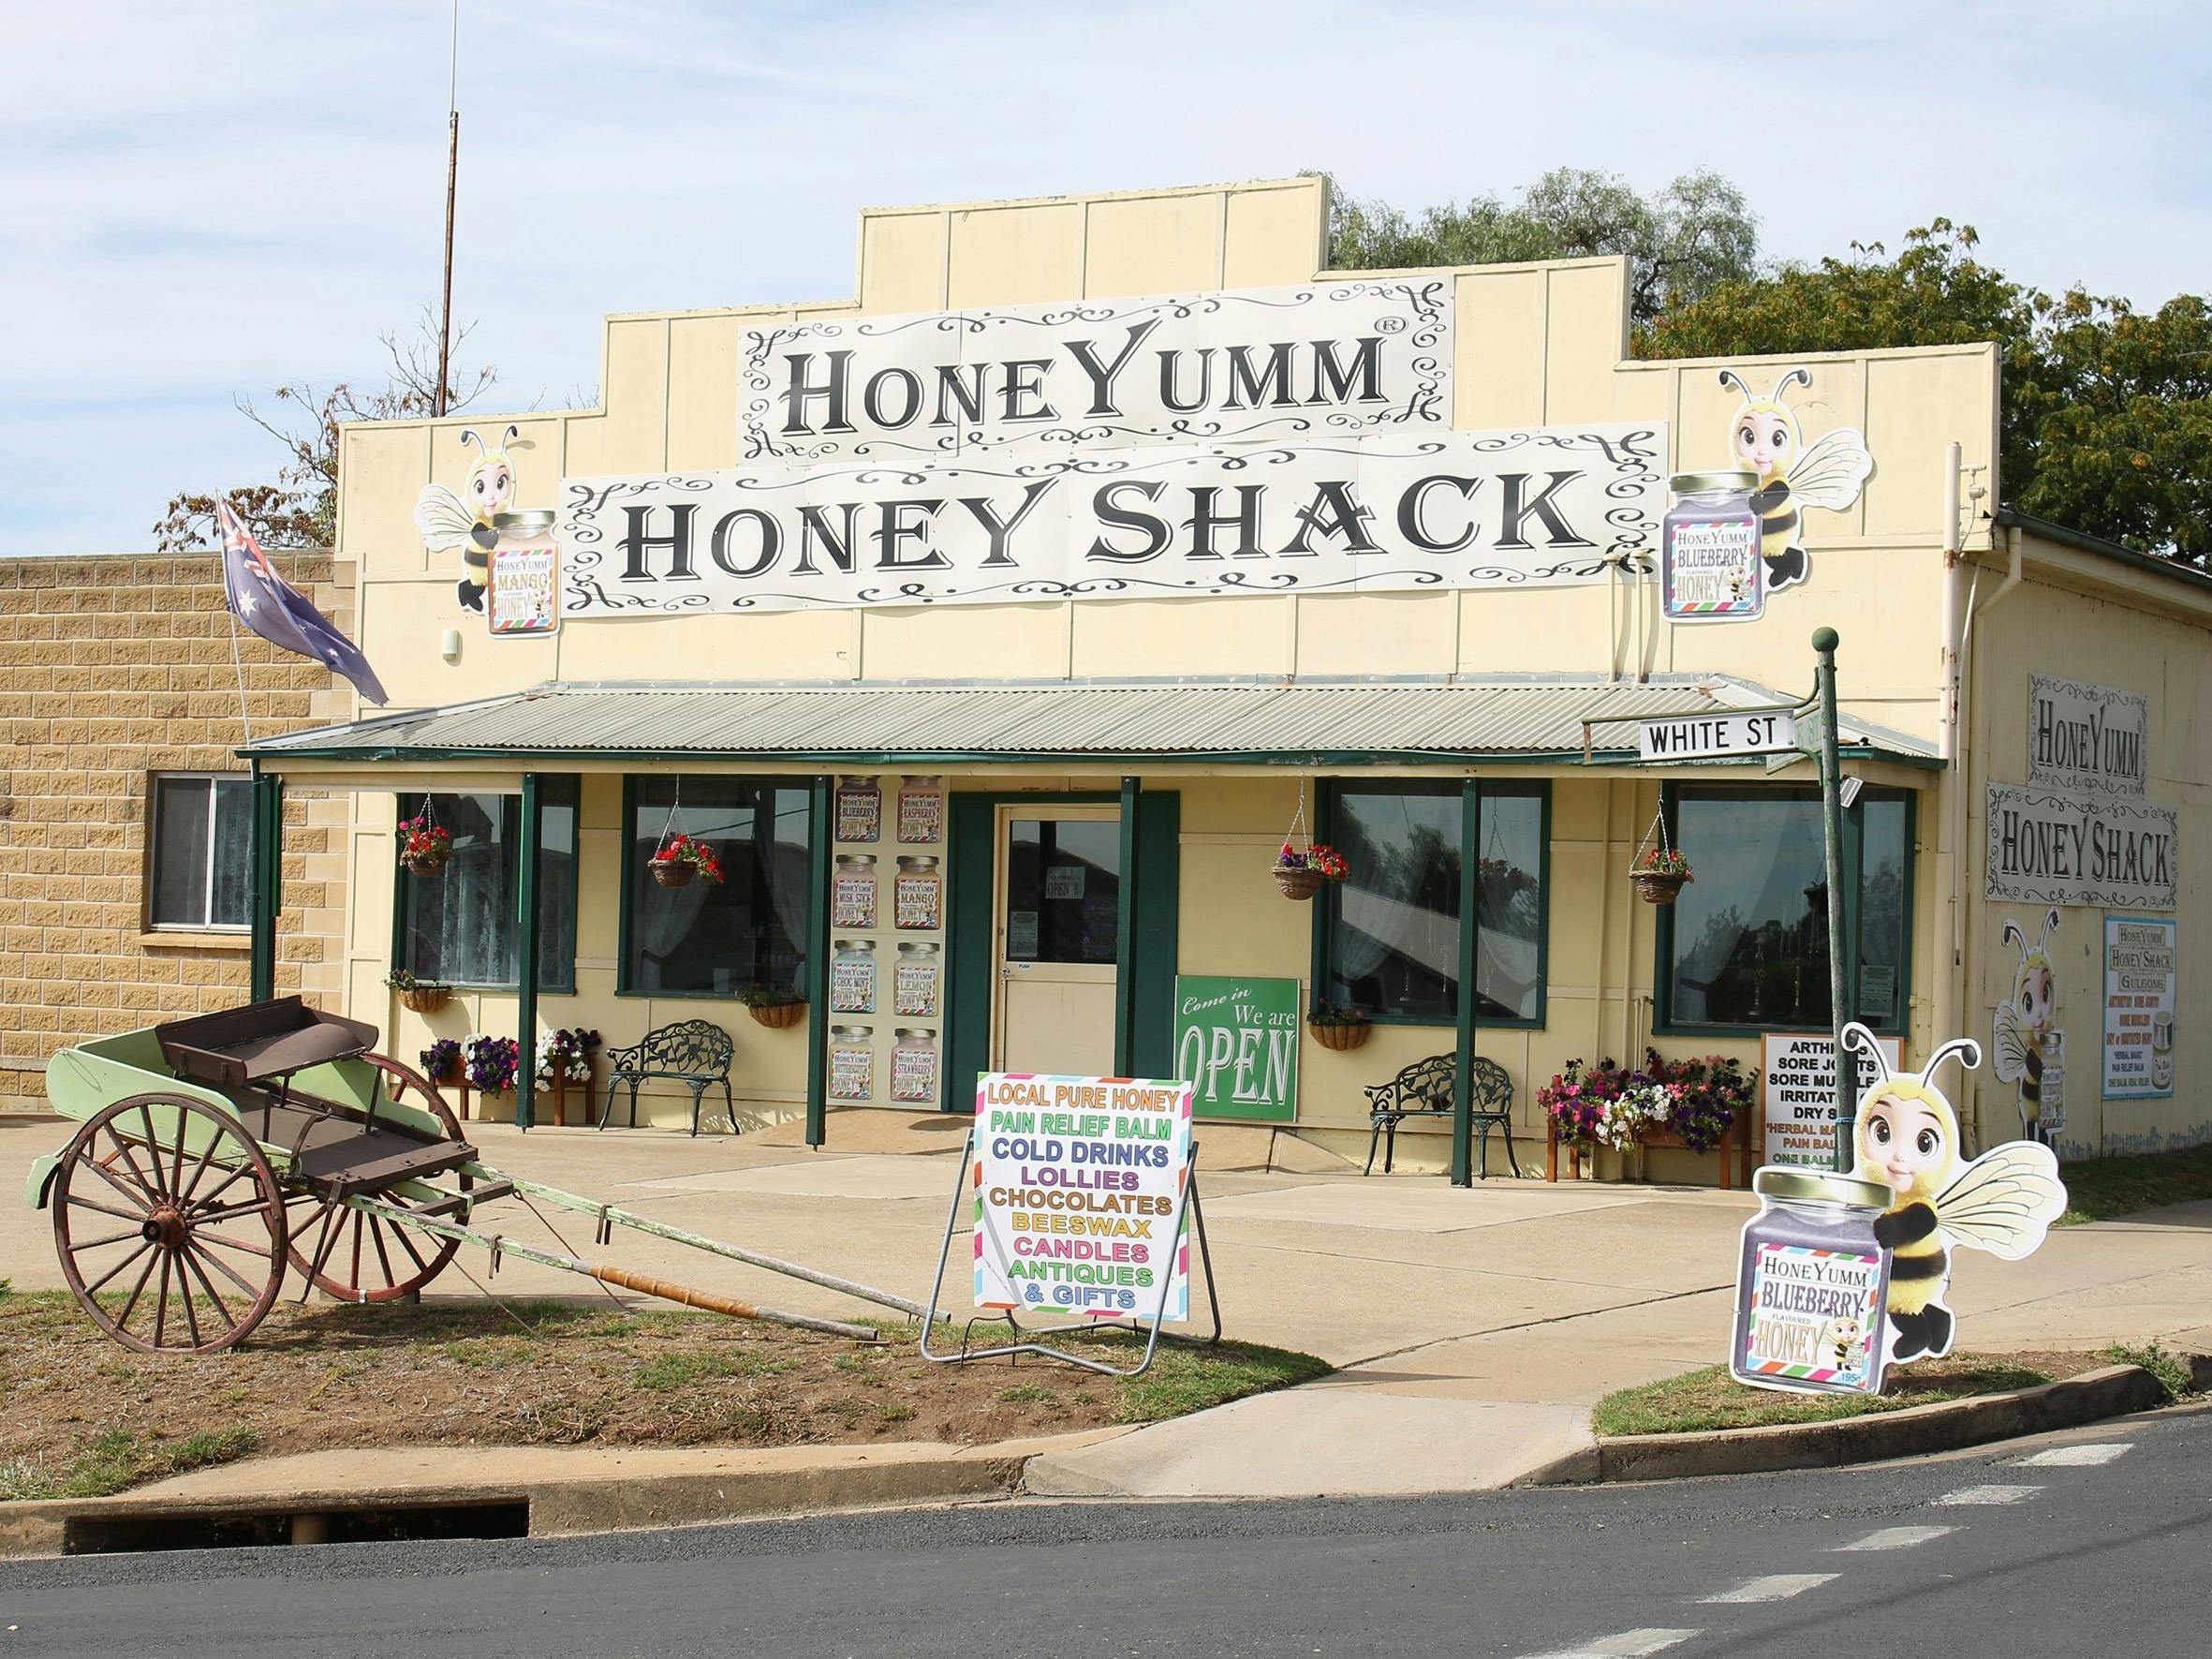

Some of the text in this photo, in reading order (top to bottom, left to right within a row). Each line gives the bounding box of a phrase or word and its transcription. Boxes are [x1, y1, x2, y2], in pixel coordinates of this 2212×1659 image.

[778, 317, 1390, 437] HONEYUMM
[615, 470, 1600, 584] HONEY SHACK
[1678, 544, 1748, 568] BLUEBERRY
[498, 573, 548, 591] MANGO
[1676, 570, 1724, 601] HONEY
[497, 592, 531, 618] HONEY
[1649, 720, 1731, 753] WHITE
[1747, 717, 1777, 746] ST
[2001, 810, 2171, 887] HONEY SHACK
[901, 893, 935, 904] MANGO
[2113, 949, 2171, 969] HONEY SHACK
[2121, 975, 2163, 989] GULGONG
[1183, 987, 1252, 1015] Come in
[1234, 1004, 1295, 1026] We are
[1179, 1025, 1296, 1105] OPEN
[1777, 1058, 1819, 1071] SORE
[1769, 1073, 1808, 1087] SORE
[987, 1083, 1180, 1112] LOCAL PURE HONEY
[1793, 1106, 1824, 1119] DRY
[990, 1111, 1172, 1141] PAIN RELIEF BALM
[992, 1137, 1170, 1167] COLD DRINKS
[1783, 1137, 1809, 1148] PAIN
[1773, 1152, 1798, 1164] ONE
[1022, 1166, 1140, 1191] LOLLIES
[989, 1187, 1173, 1215] CHOCOLATES
[1011, 1211, 1153, 1238] BEESWAX
[1013, 1237, 1150, 1263] CANDLES
[1008, 1260, 1154, 1287] ANTIQUES
[1025, 1283, 1136, 1309] & GIFTS
[1762, 1281, 1867, 1320] BLUEBERRY
[1772, 1313, 1811, 1325] FLAVOURED
[1754, 1319, 1828, 1365] HONEY
